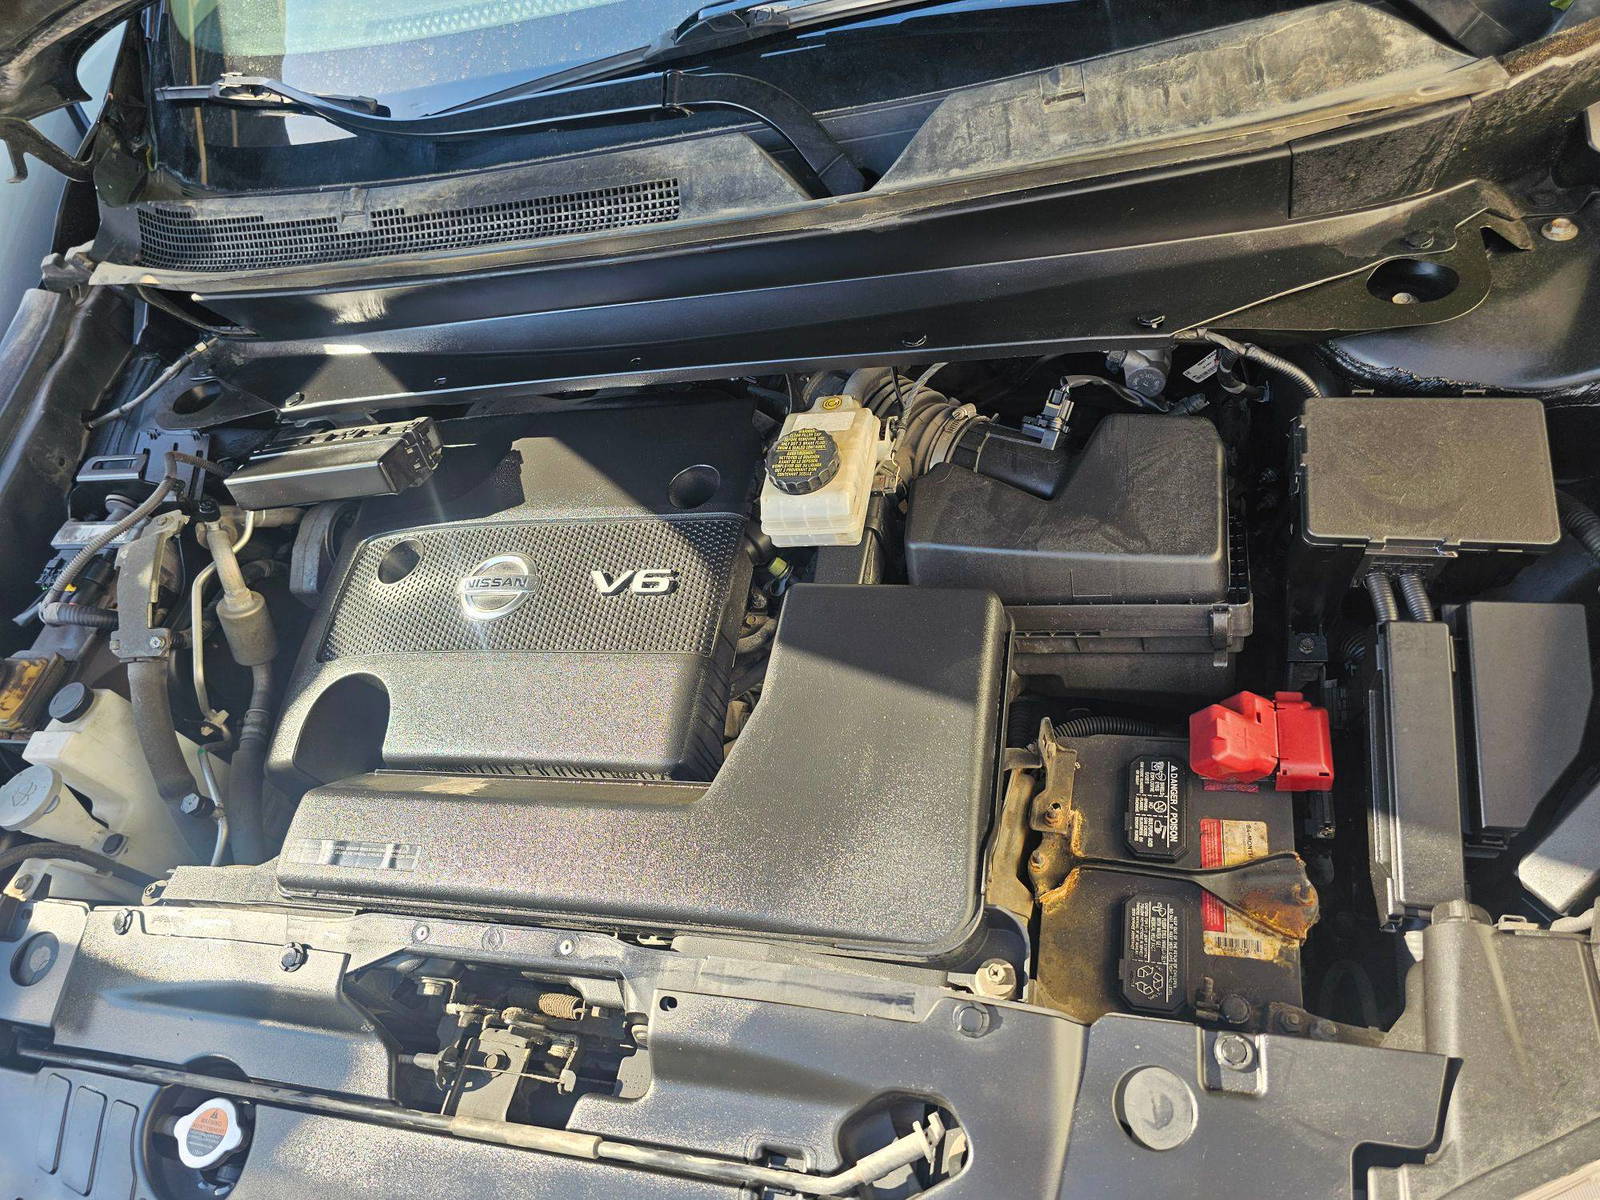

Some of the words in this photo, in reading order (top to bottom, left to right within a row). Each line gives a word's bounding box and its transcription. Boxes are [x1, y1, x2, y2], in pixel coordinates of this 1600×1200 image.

[466, 576, 527, 589] NISSAN
[591, 569, 677, 596] V6
[1170, 813, 1178, 842] POISON
